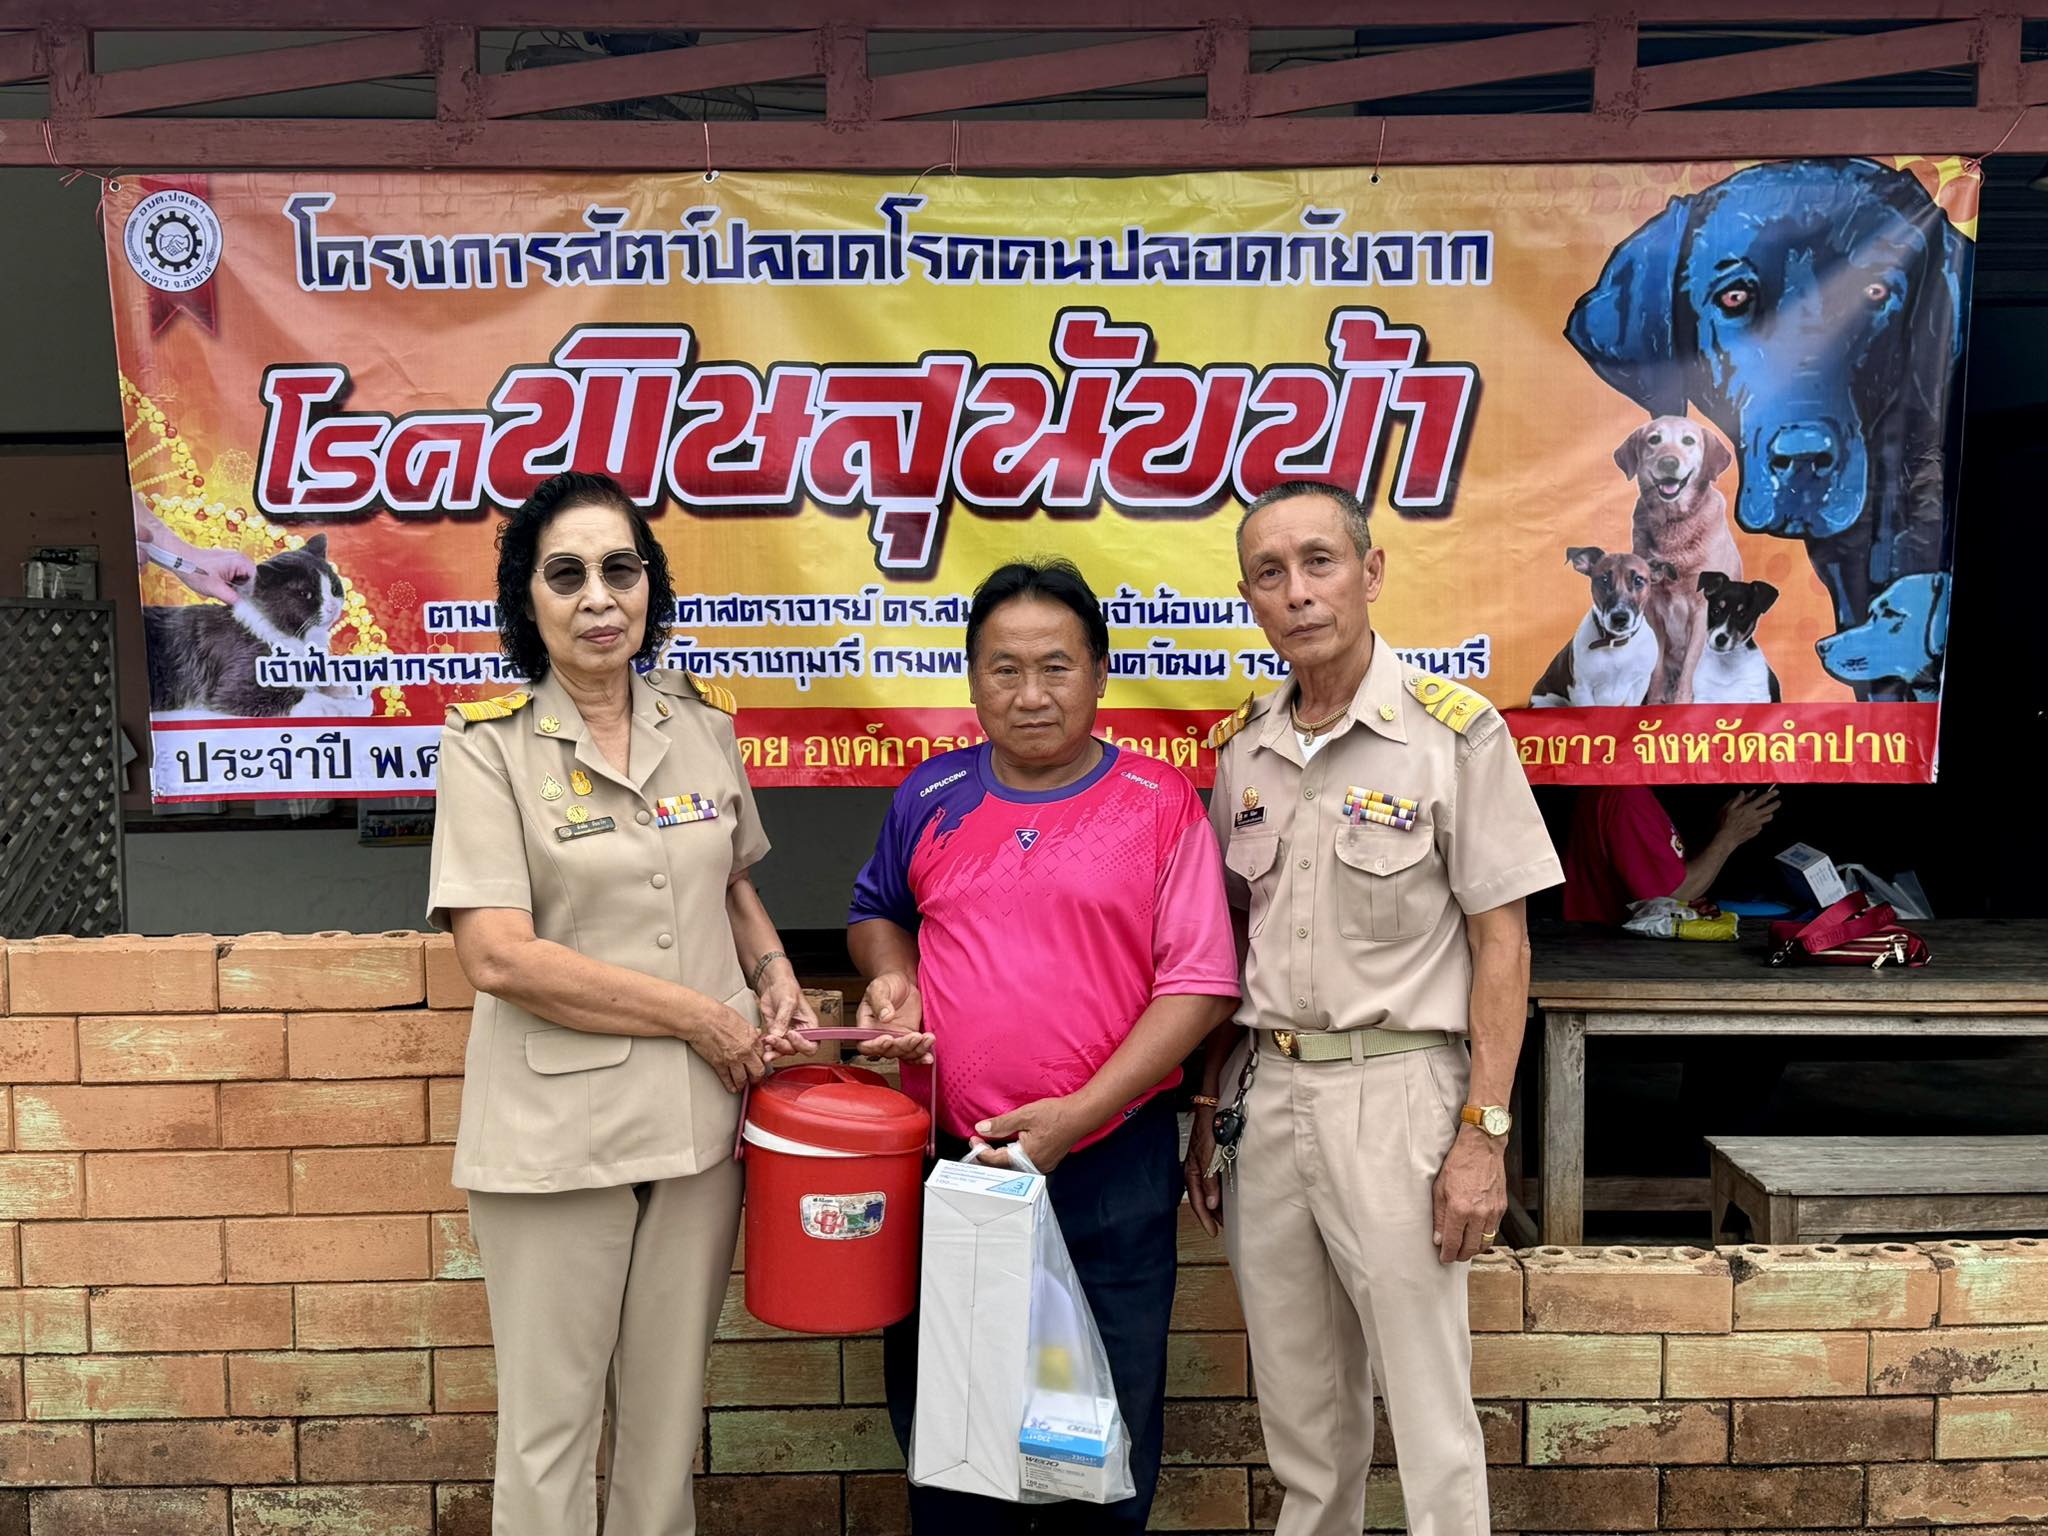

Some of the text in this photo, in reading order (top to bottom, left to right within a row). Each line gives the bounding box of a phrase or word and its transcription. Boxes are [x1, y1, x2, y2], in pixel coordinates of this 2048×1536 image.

[676, 588, 880, 622] ศาสตราจารย์
[1102, 587, 1258, 624] เจ้าน้องนา
[873, 651, 968, 673] กรมพ
[176, 732, 352, 783] ประจำปี
[738, 736, 788, 767] ดย
[1515, 734, 1616, 765] องาว
[1632, 719, 1906, 764] จังหวัดลำปาง
[919, 770, 967, 798] CAPPUCCINO
